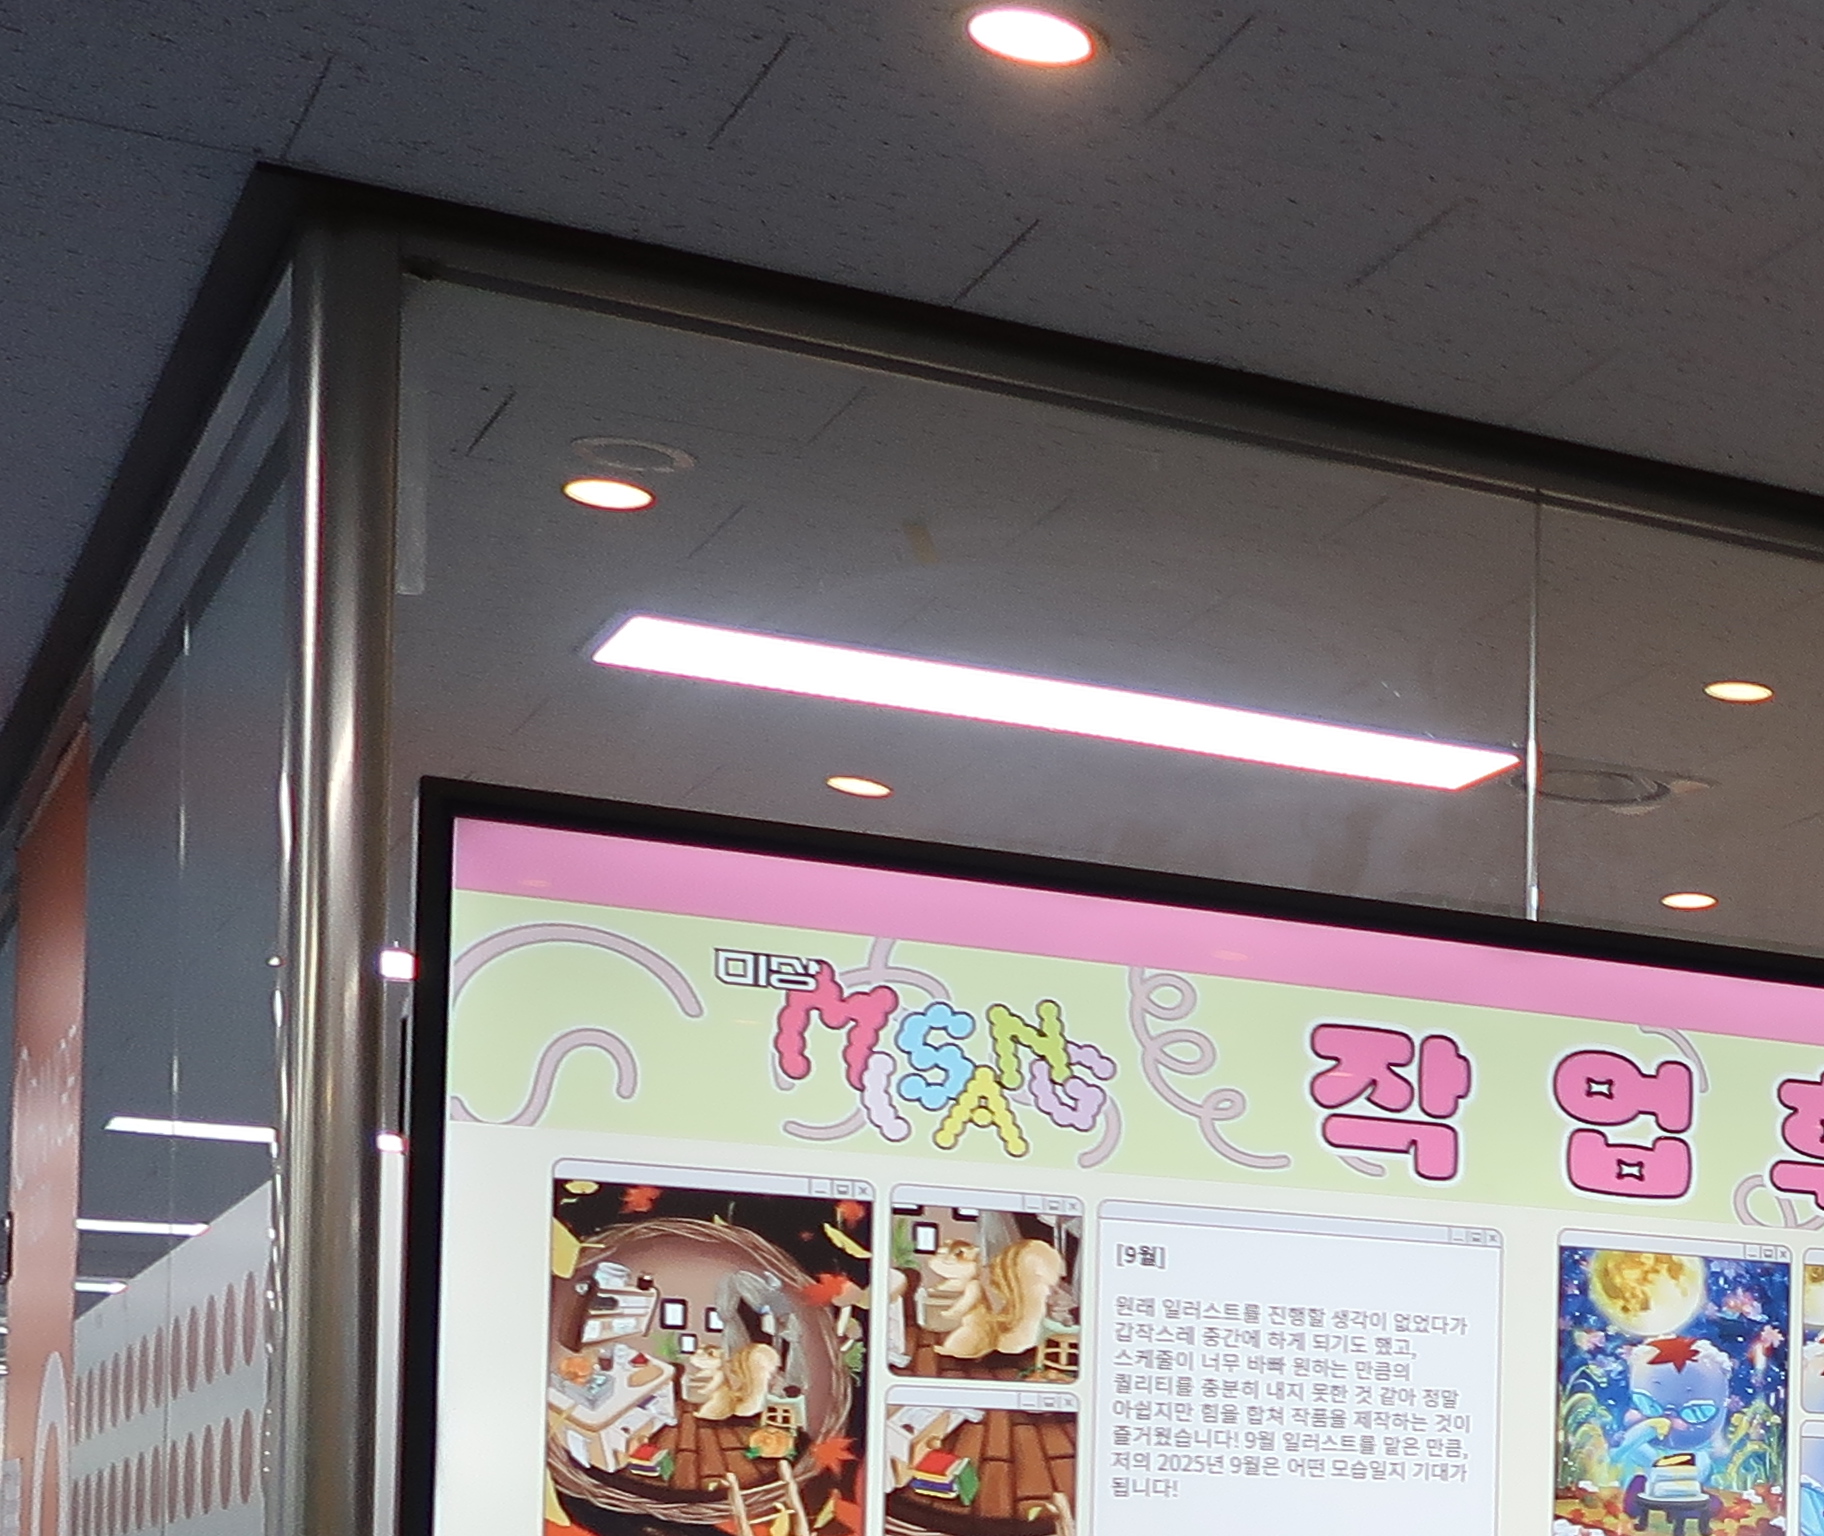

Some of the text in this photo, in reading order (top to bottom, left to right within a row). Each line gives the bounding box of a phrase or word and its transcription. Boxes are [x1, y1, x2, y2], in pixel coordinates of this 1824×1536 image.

[1115, 1243, 1165, 1269] [9월]
[1161, 1298, 1467, 1336] 일러스트를 진행할 생각이 없었다가
[1114, 1321, 1417, 1359] 갑작스레 되기도 했고,
[1200, 1351, 1240, 1373] 너무
[1354, 1359, 1410, 1382] 만큼의
[1310, 1382, 1348, 1404] 못한
[1354, 1385, 1372, 1405] 것
[1378, 1385, 1417, 1407] 같아
[1434, 1413, 1470, 1433] 것이
[1112, 1424, 1239, 1449] 즐거웠습니다!
[1244, 1429, 1275, 1451] 9월
[1282, 1431, 1377, 1455] 일러스트를
[1110, 1450, 1150, 1471] 저의
[1156, 1452, 1224, 1474] 2025년
[1229, 1454, 1281, 1476] 9월은
[1330, 1458, 1405, 1481] 모습일지
[1412, 1461, 1467, 1482] 기대가
[1109, 1476, 1178, 1498] 됩니다!
